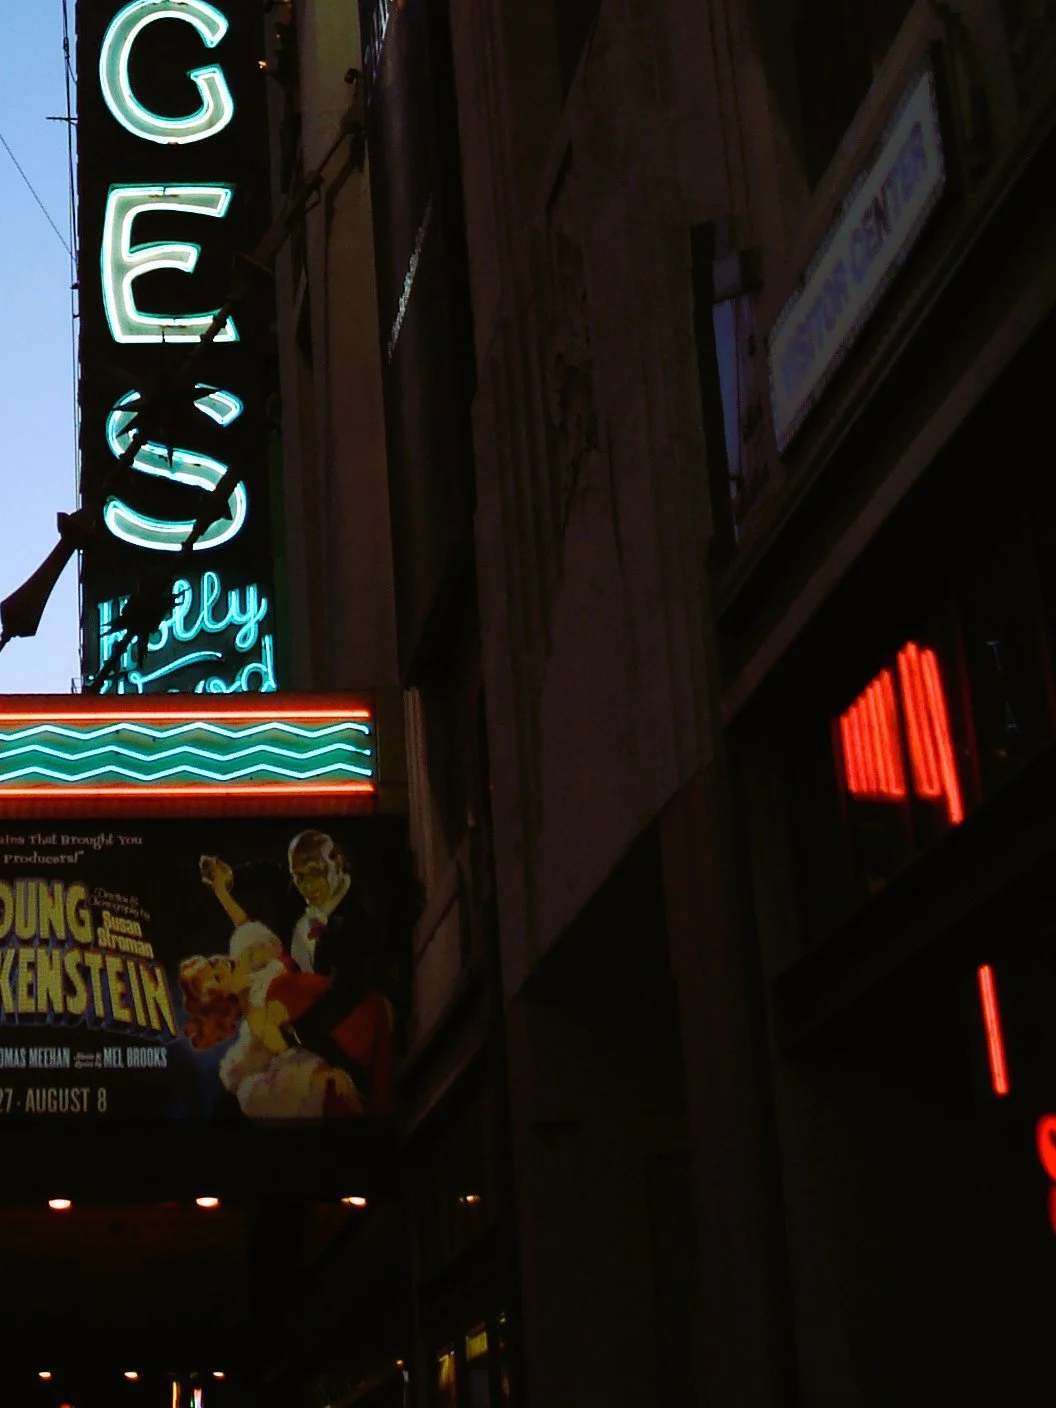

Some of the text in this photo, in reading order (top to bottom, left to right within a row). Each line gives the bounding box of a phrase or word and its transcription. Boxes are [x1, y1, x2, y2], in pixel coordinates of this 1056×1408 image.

[28, 833, 57, 846] That
[60, 832, 114, 850] Brought
[117, 835, 143, 846] You
[101, 908, 144, 940] Susan
[96, 926, 156, 962] Stroman
[28, 1046, 71, 1069] MEEHAN
[103, 1046, 124, 1069] MEL
[126, 1046, 167, 1069] BROOKS
[25, 1087, 90, 1114] AUGUST
[96, 1087, 108, 1114] 8
